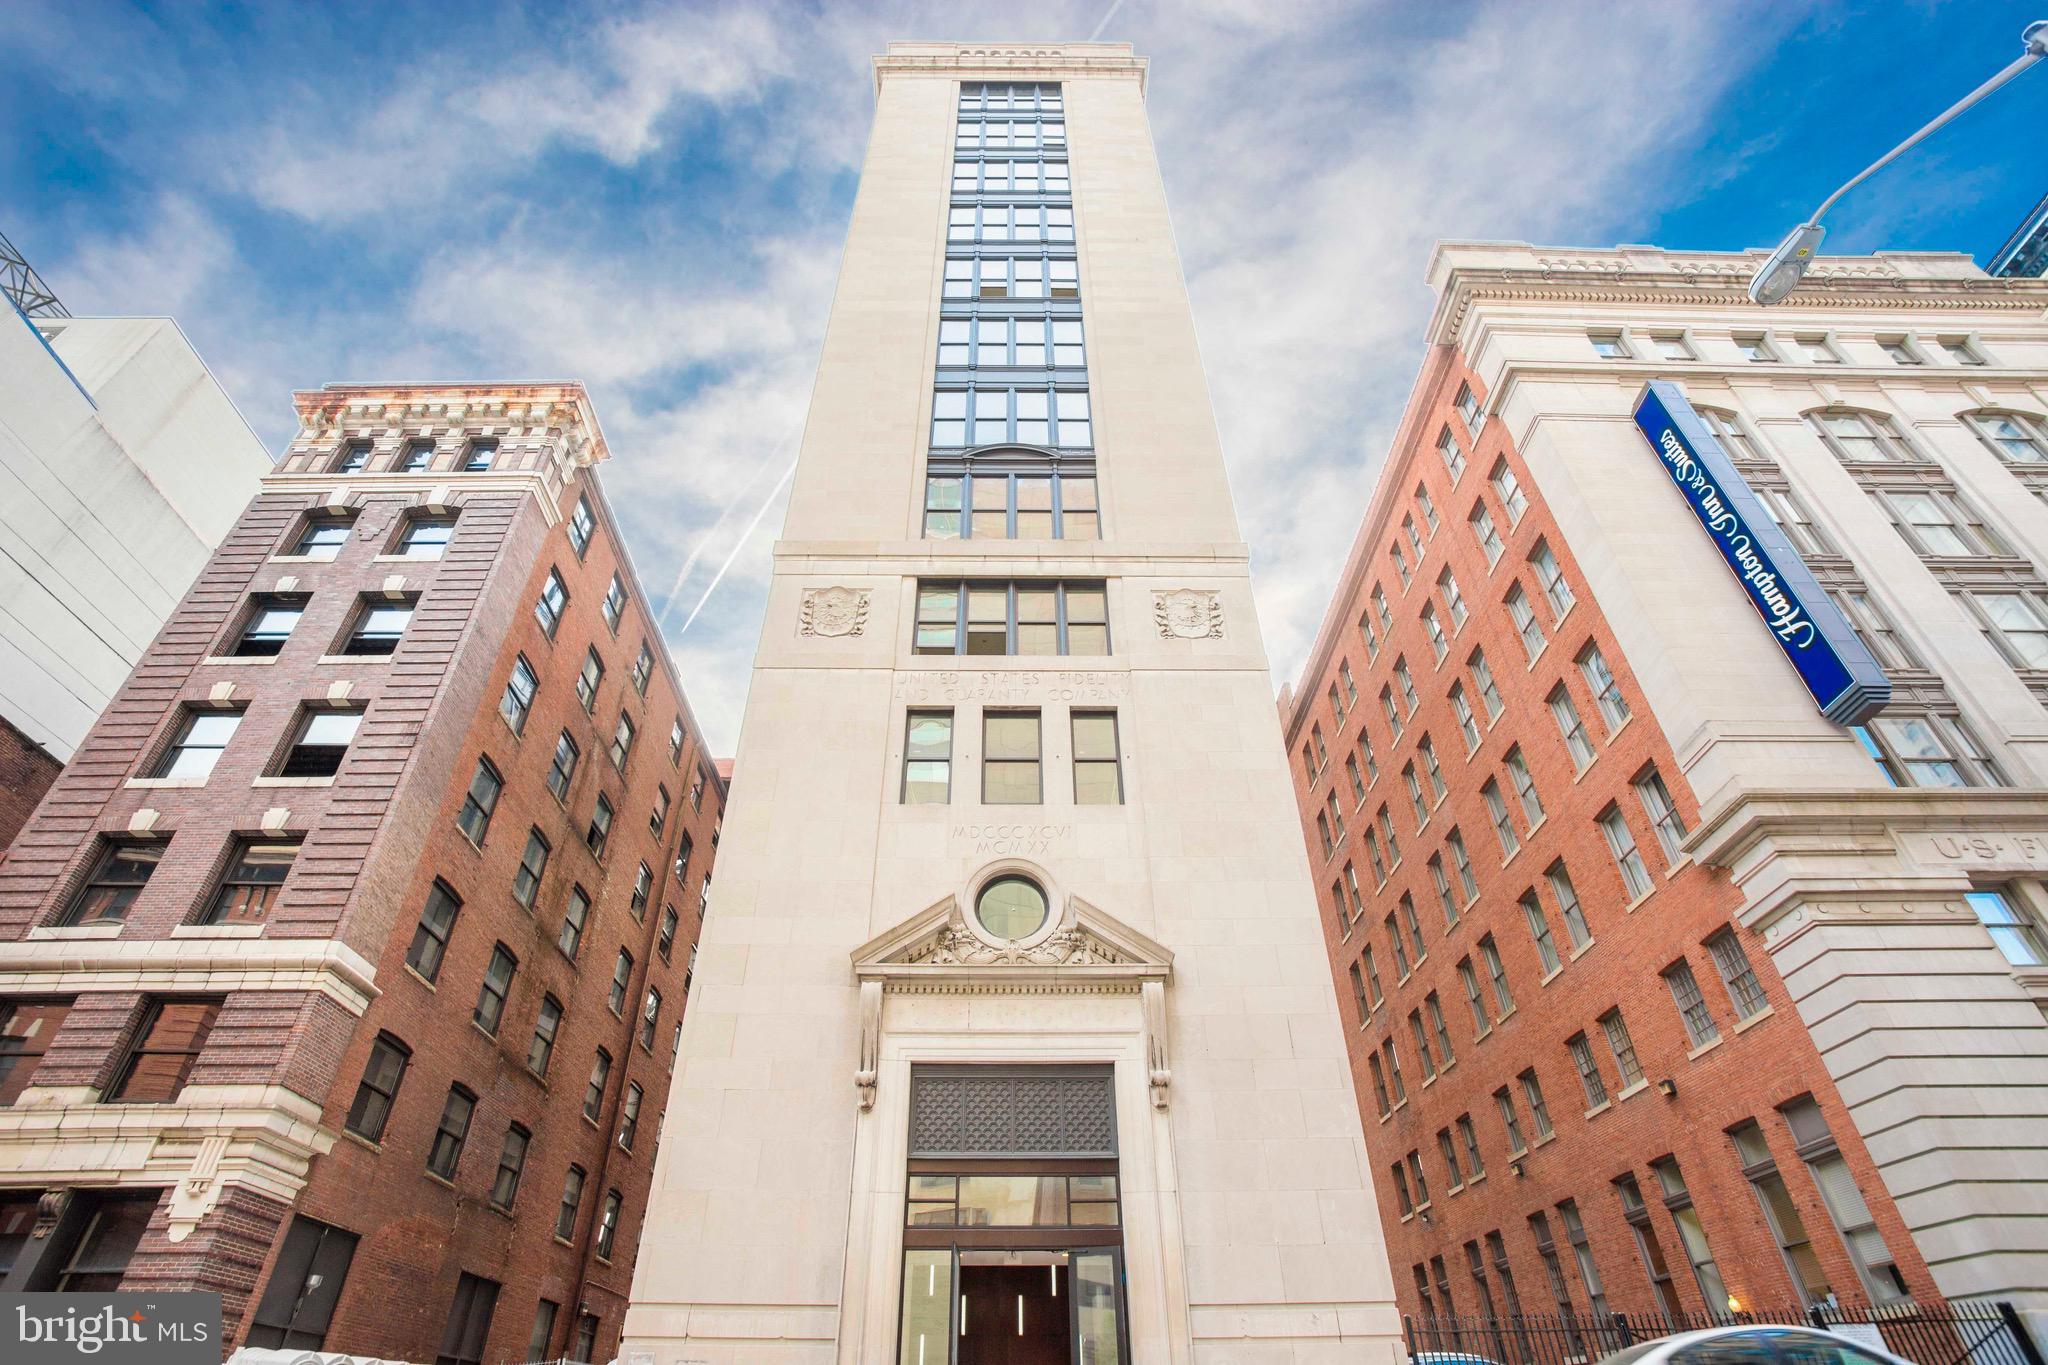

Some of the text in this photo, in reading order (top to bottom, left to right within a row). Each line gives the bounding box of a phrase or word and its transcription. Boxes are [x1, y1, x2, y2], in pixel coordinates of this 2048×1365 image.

[1660, 428, 1815, 649] Hampton Inn & Suites
[897, 672, 1131, 685] UNITED STATES FIDELITY
[895, 688, 1130, 701] AND GUARANTY COMPANY
[952, 825, 1072, 839] MDCCCXCVI
[976, 840, 1049, 854] MCMXX
